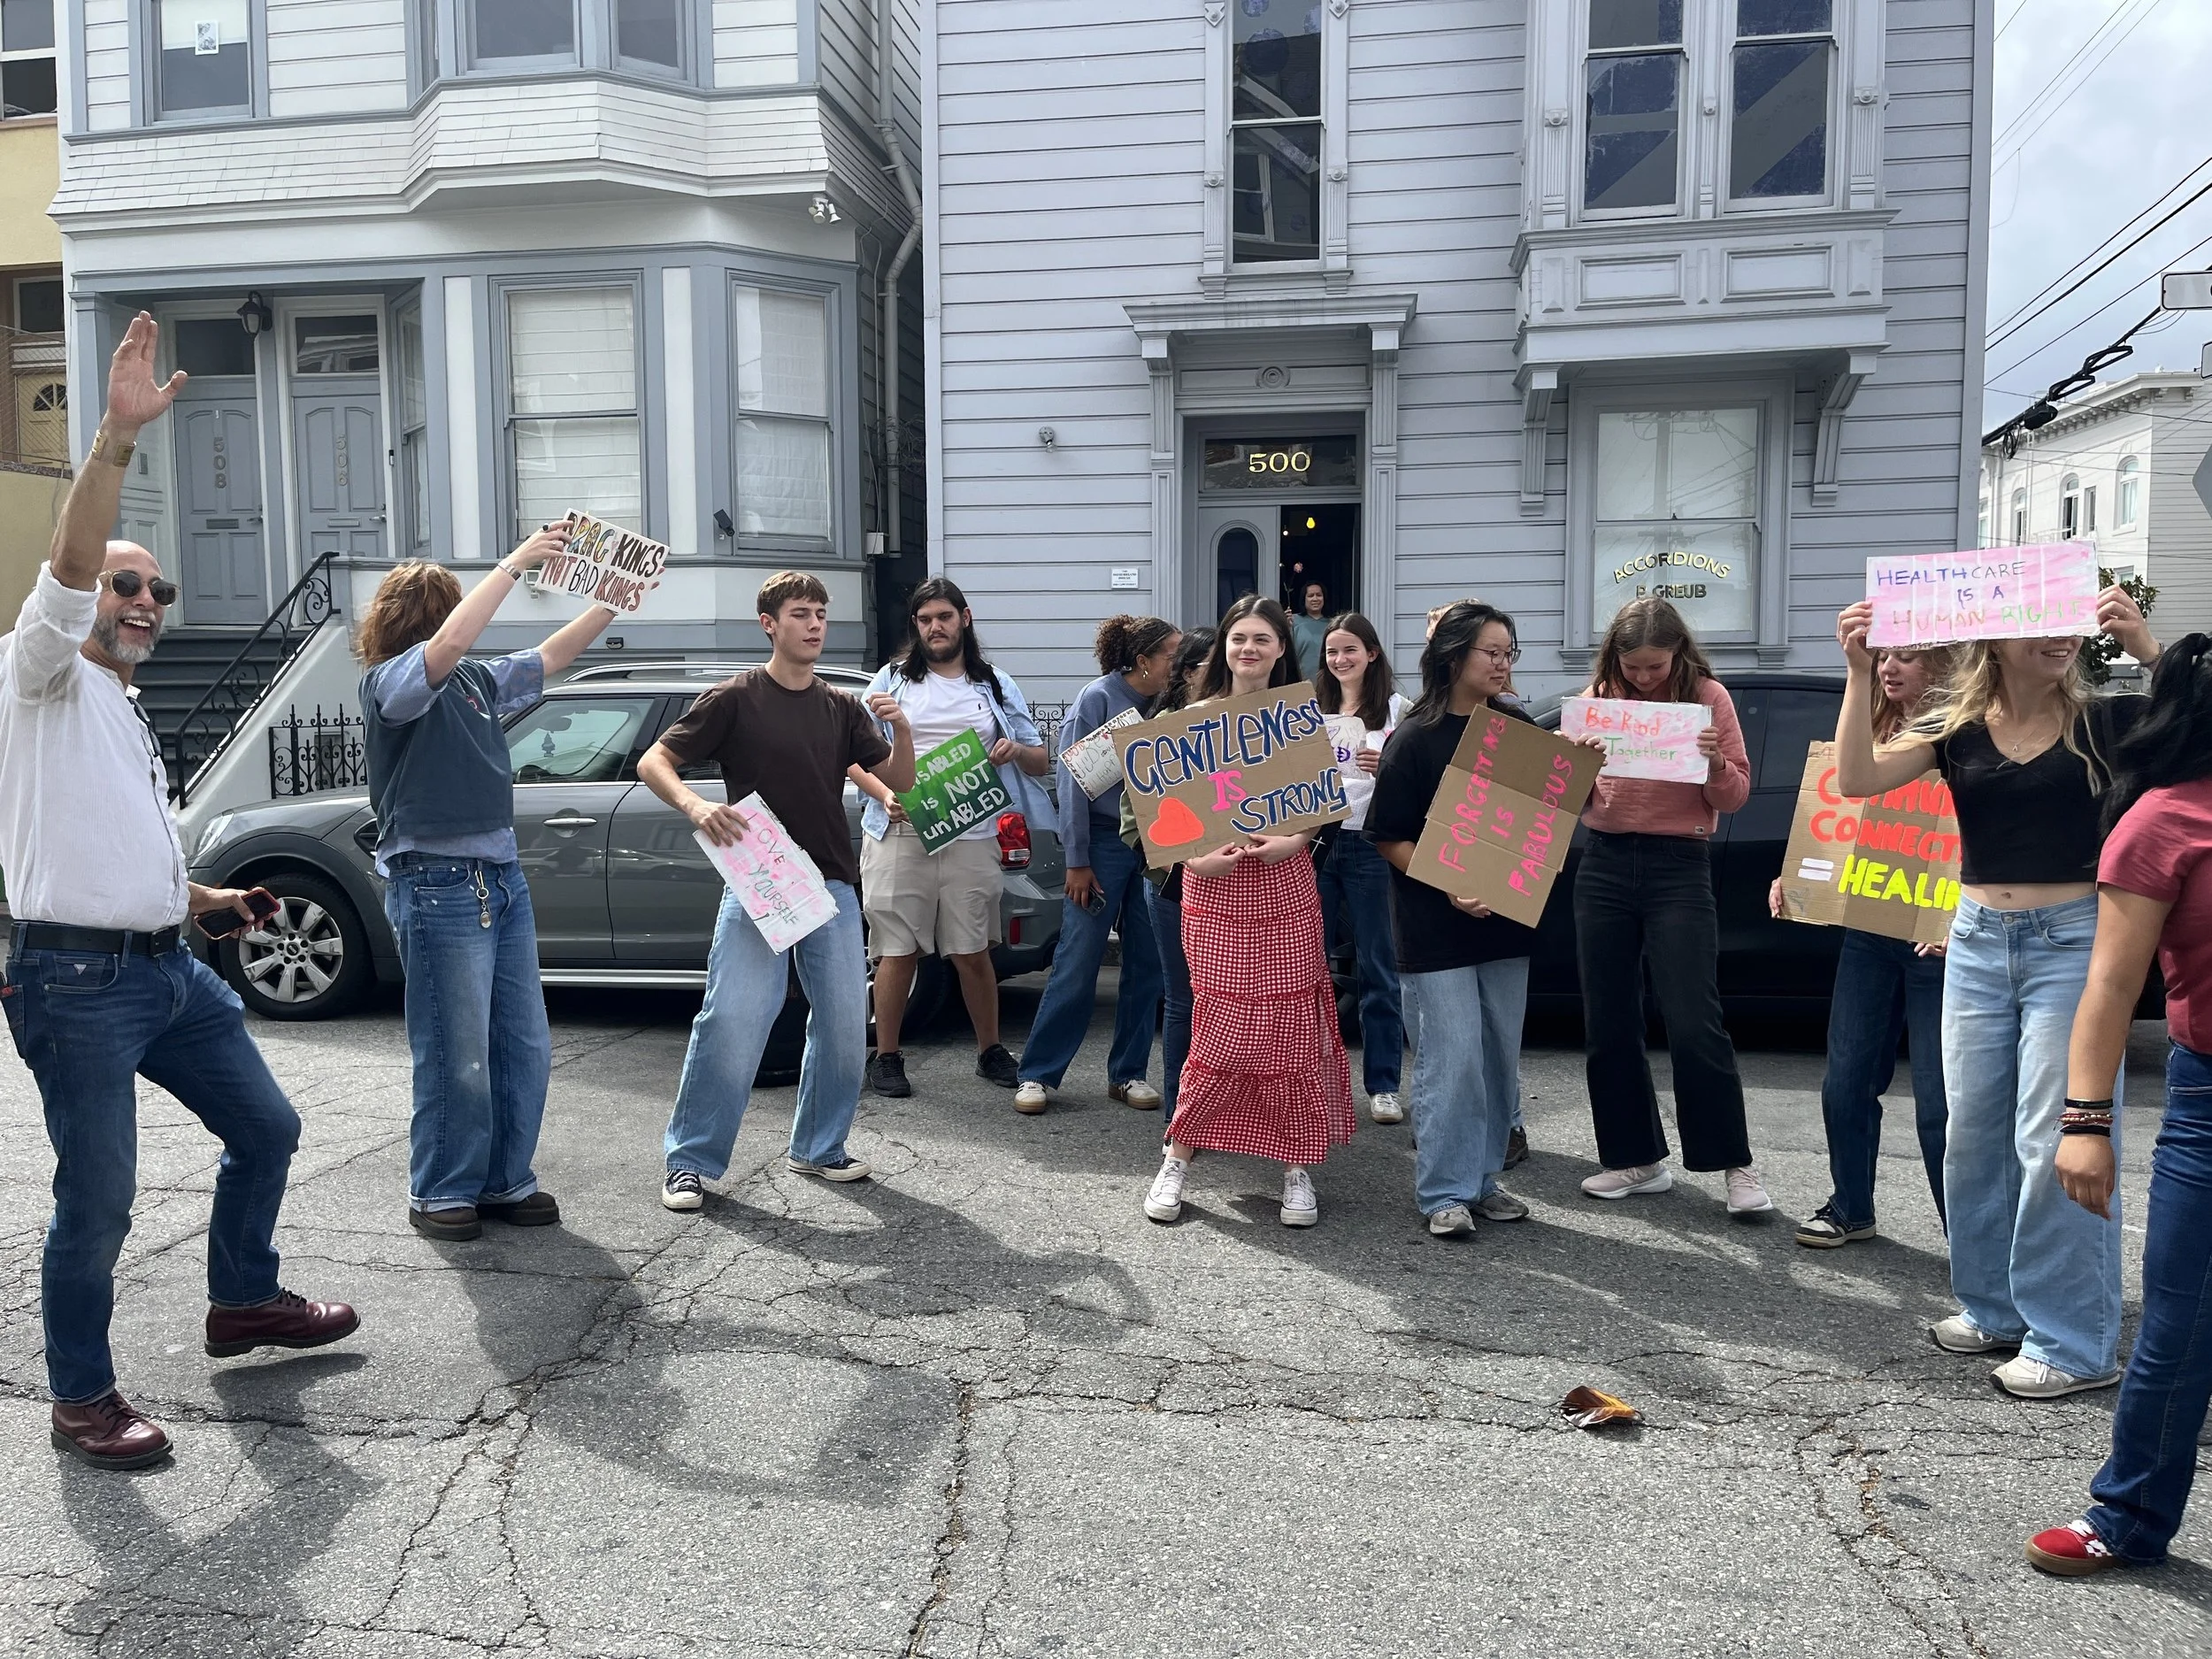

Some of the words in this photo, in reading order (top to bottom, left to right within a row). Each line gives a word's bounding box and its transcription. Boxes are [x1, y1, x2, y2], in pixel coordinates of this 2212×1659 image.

[213, 436, 227, 488] 508
[335, 434, 348, 487] 506
[1248, 451, 1311, 472] 500
[611, 534, 665, 578] KINGS
[1614, 551, 1732, 584] ACCORDIONS
[1877, 561, 2026, 586] HEALTHCARE
[541, 555, 578, 588] NOT
[568, 559, 599, 595] BAD
[594, 569, 646, 612] KINGS
[1653, 584, 1707, 599] GREUB
[1957, 588, 1974, 609] IS
[1993, 586, 2004, 599] A
[1893, 610, 1986, 631] HUMAN
[2001, 601, 2083, 626] RIGHT
[1586, 706, 1612, 728] Be
[1603, 736, 1678, 764] Together
[943, 758, 989, 804] NOT
[1207, 770, 1248, 812] IS
[1231, 767, 1348, 834] STRONG
[1437, 716, 1508, 873] FORGETTING
[1489, 806, 1516, 839] IS
[1507, 754, 1574, 897] FABULOUS
[1809, 810, 1962, 864] CONNECT
[749, 862, 800, 925] YOURSELF
